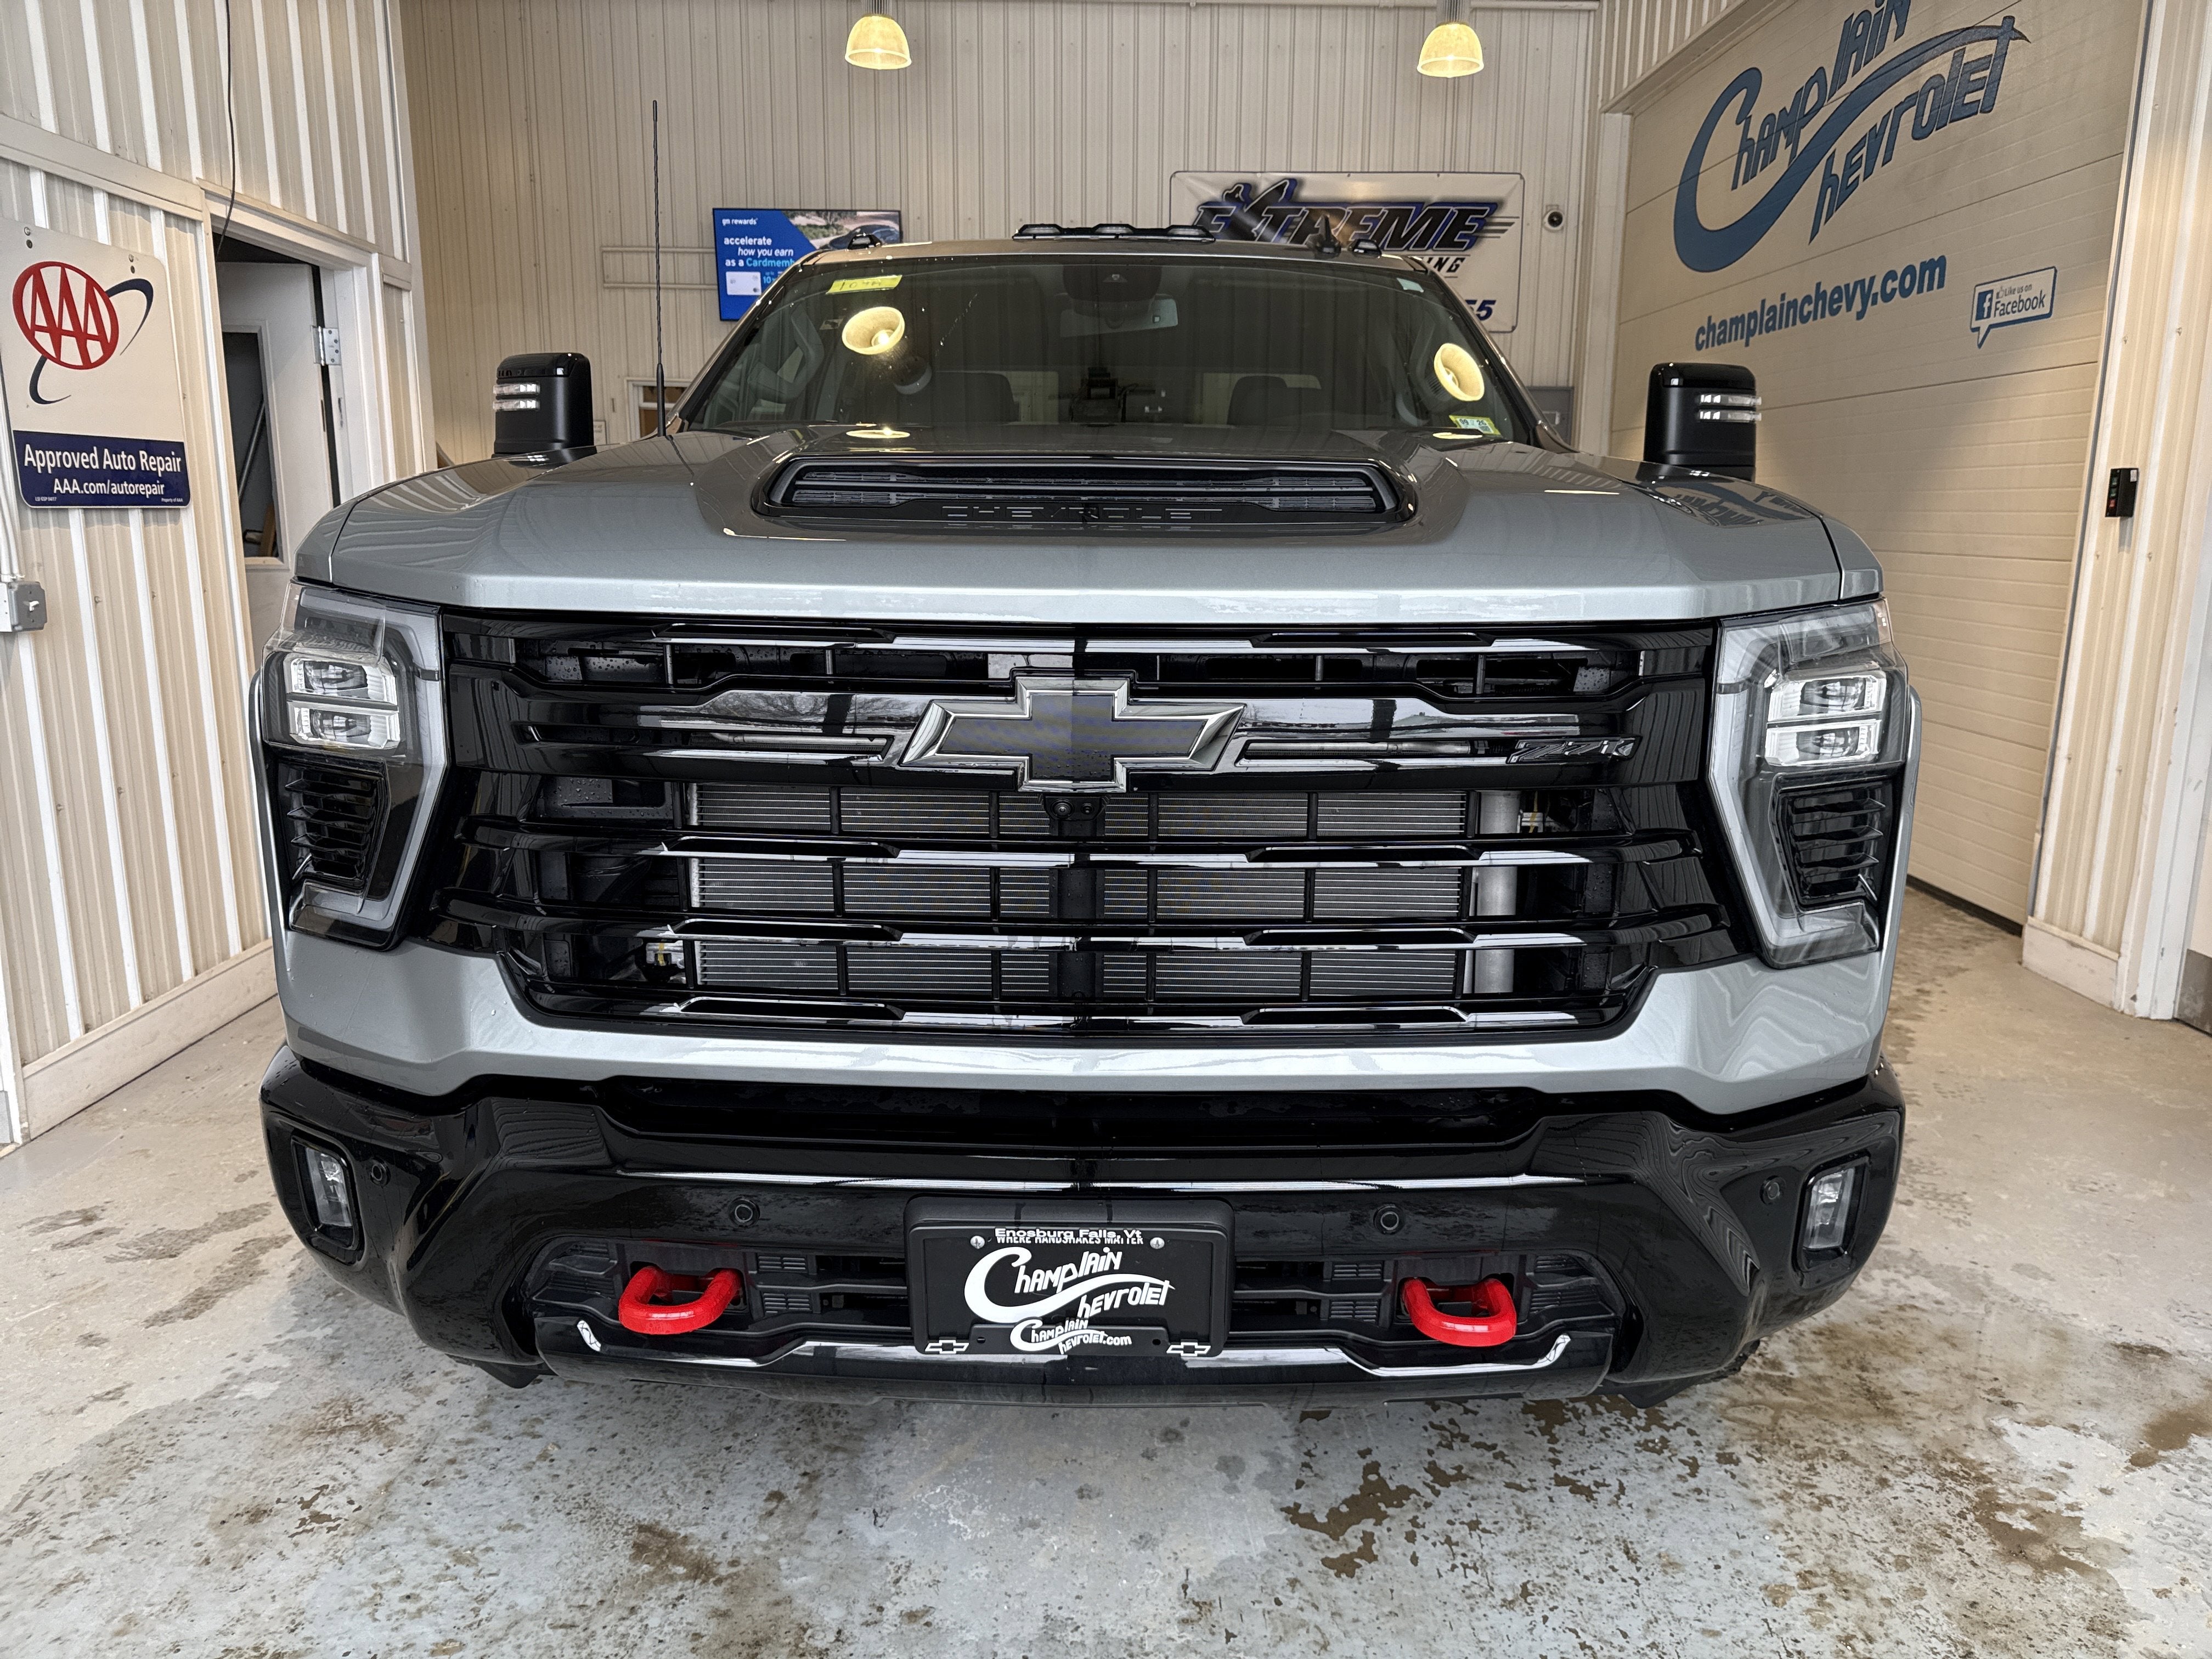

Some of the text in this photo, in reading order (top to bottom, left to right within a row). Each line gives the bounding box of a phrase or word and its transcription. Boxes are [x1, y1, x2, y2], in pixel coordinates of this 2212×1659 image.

[724, 236, 772, 245] accelerate
[738, 247, 755, 256] how
[757, 249, 772, 258] you
[2005, 284, 2032, 296] Like us on
[1695, 255, 1946, 351] champlainchevy.com
[1994, 290, 2046, 318] Facebook
[27, 264, 112, 367] AAA
[24, 444, 181, 477] Approved Auto Repair
[53, 478, 165, 498] AAA.com/autorepair
[995, 1228, 1142, 1239] Enosburg Falls, Vt
